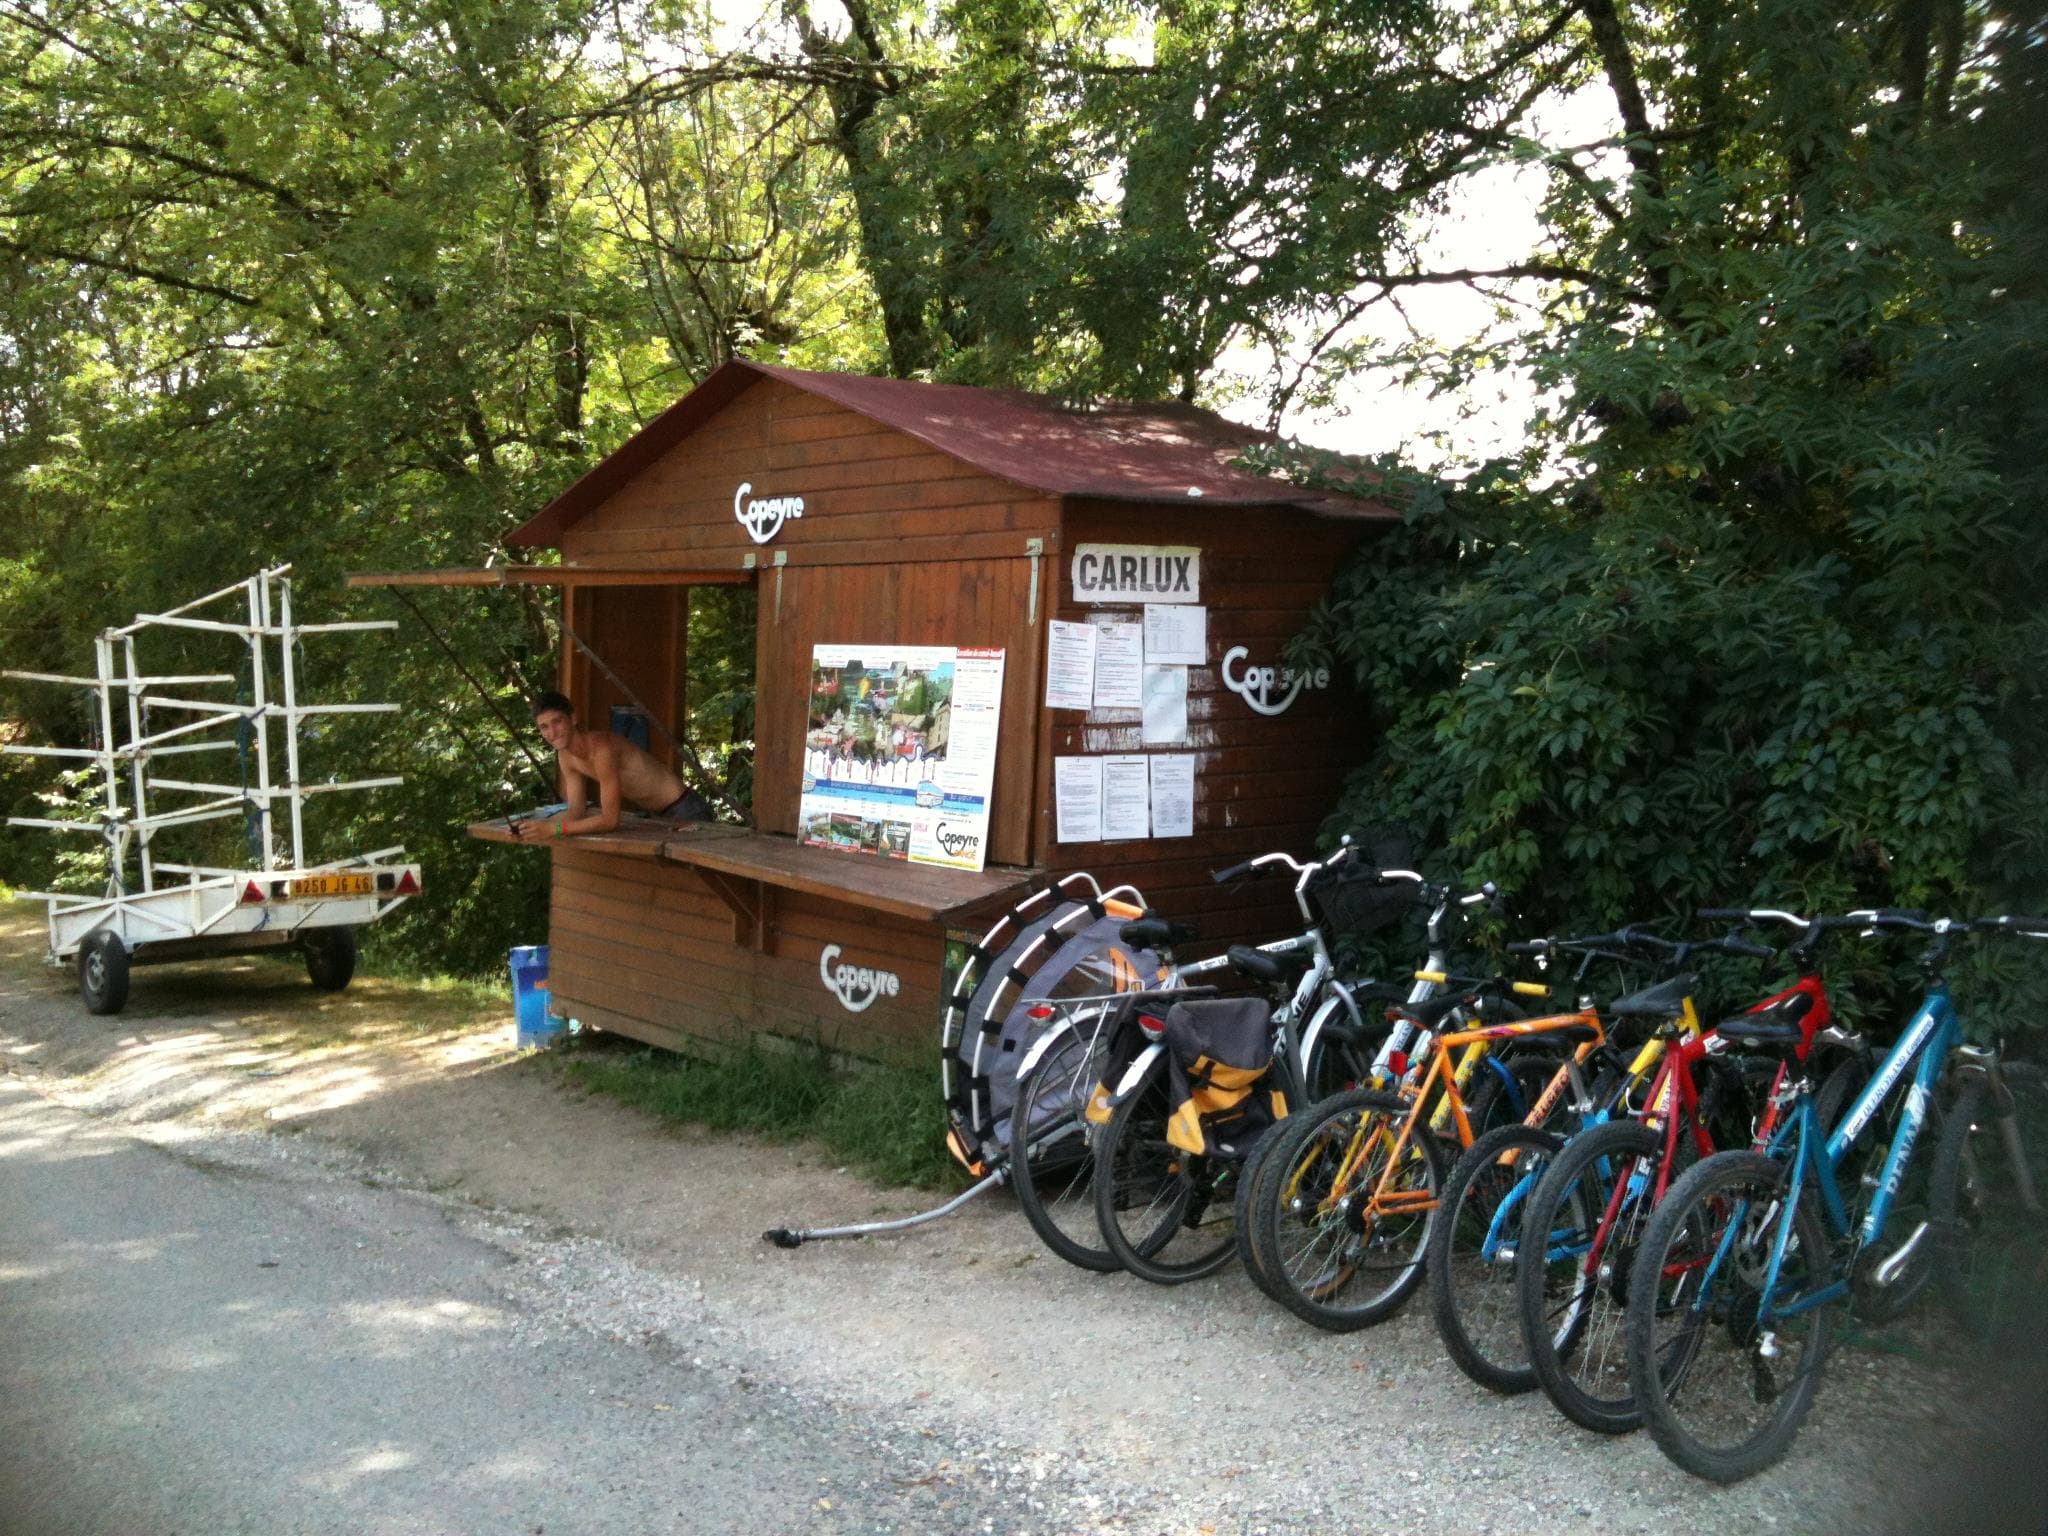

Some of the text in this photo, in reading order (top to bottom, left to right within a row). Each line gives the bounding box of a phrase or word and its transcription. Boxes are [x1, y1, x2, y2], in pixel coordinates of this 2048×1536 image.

[734, 482, 805, 544] Copeyre
[1079, 553, 1191, 593] CARLUX
[935, 822, 979, 857] Copeyre
[334, 877, 348, 891] JG
[355, 876, 370, 890] 46
[820, 943, 899, 1012] Copeyre
